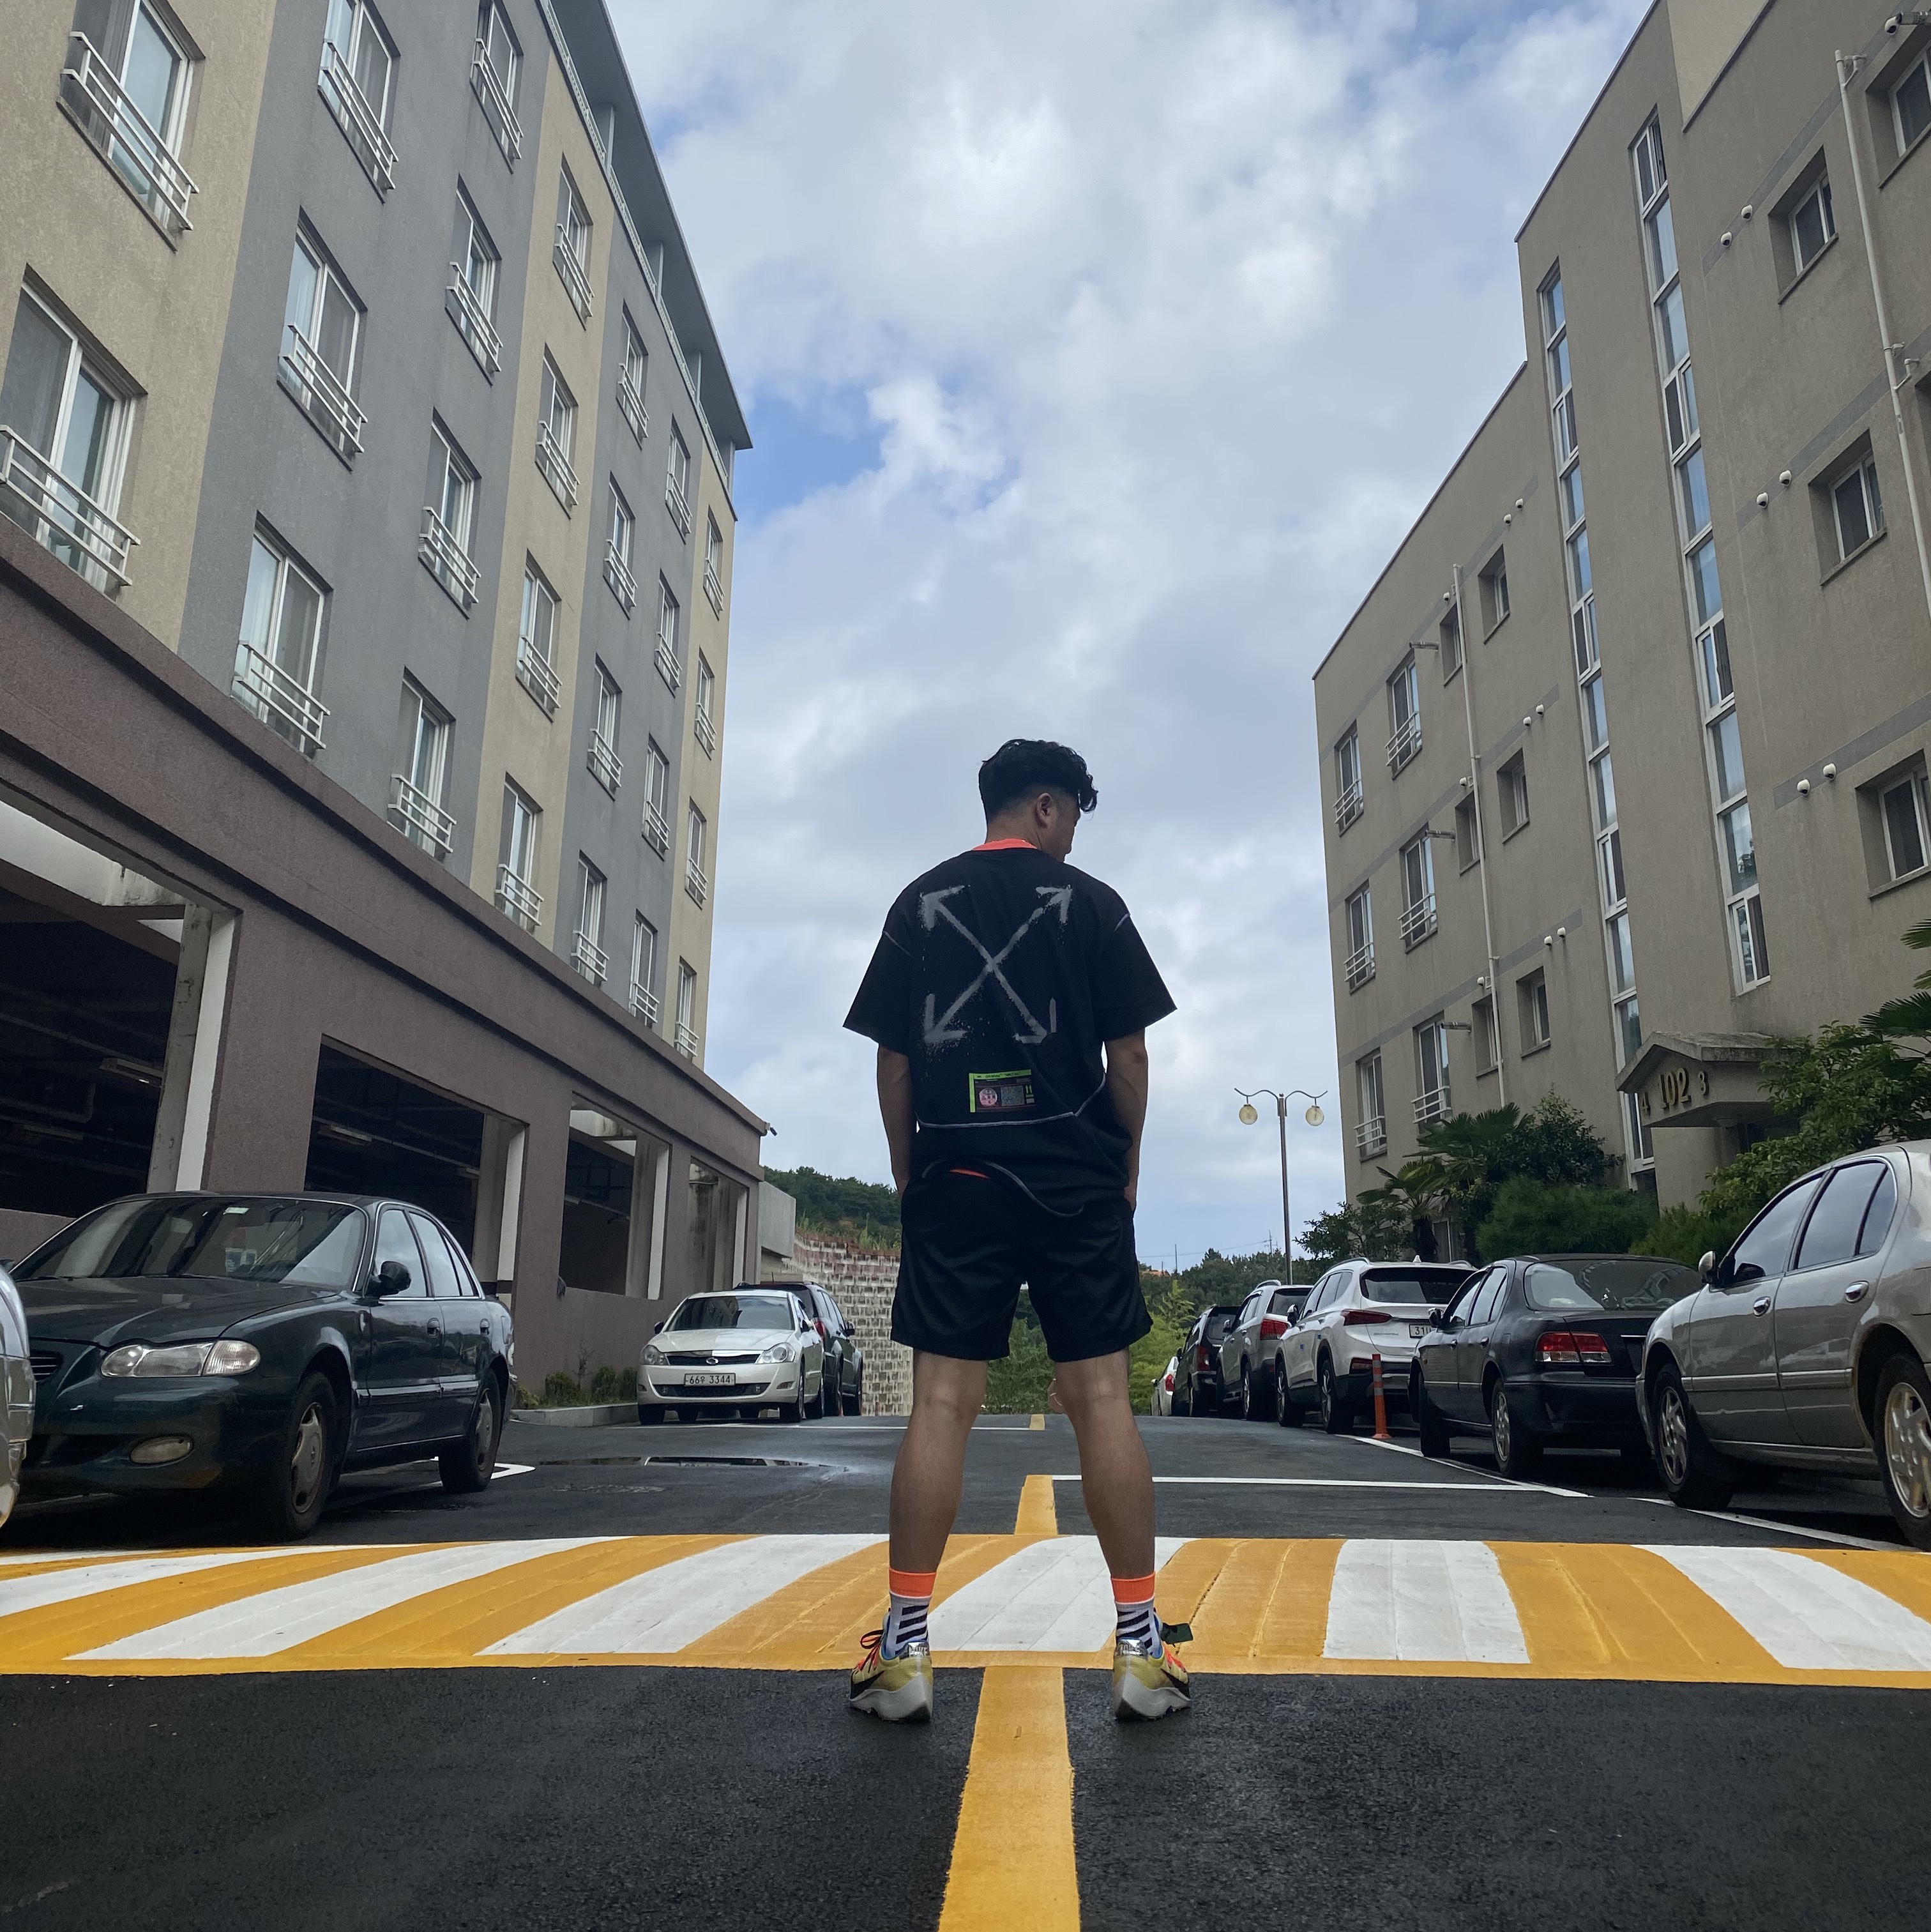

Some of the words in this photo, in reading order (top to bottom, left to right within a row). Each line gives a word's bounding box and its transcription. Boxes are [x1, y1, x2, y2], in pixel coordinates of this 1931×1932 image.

[1640, 1092, 1651, 1116] 4
[1658, 1067, 1691, 1109] 102
[1699, 1070, 1709, 1096] 3
[709, 1375, 731, 1384] 3344
